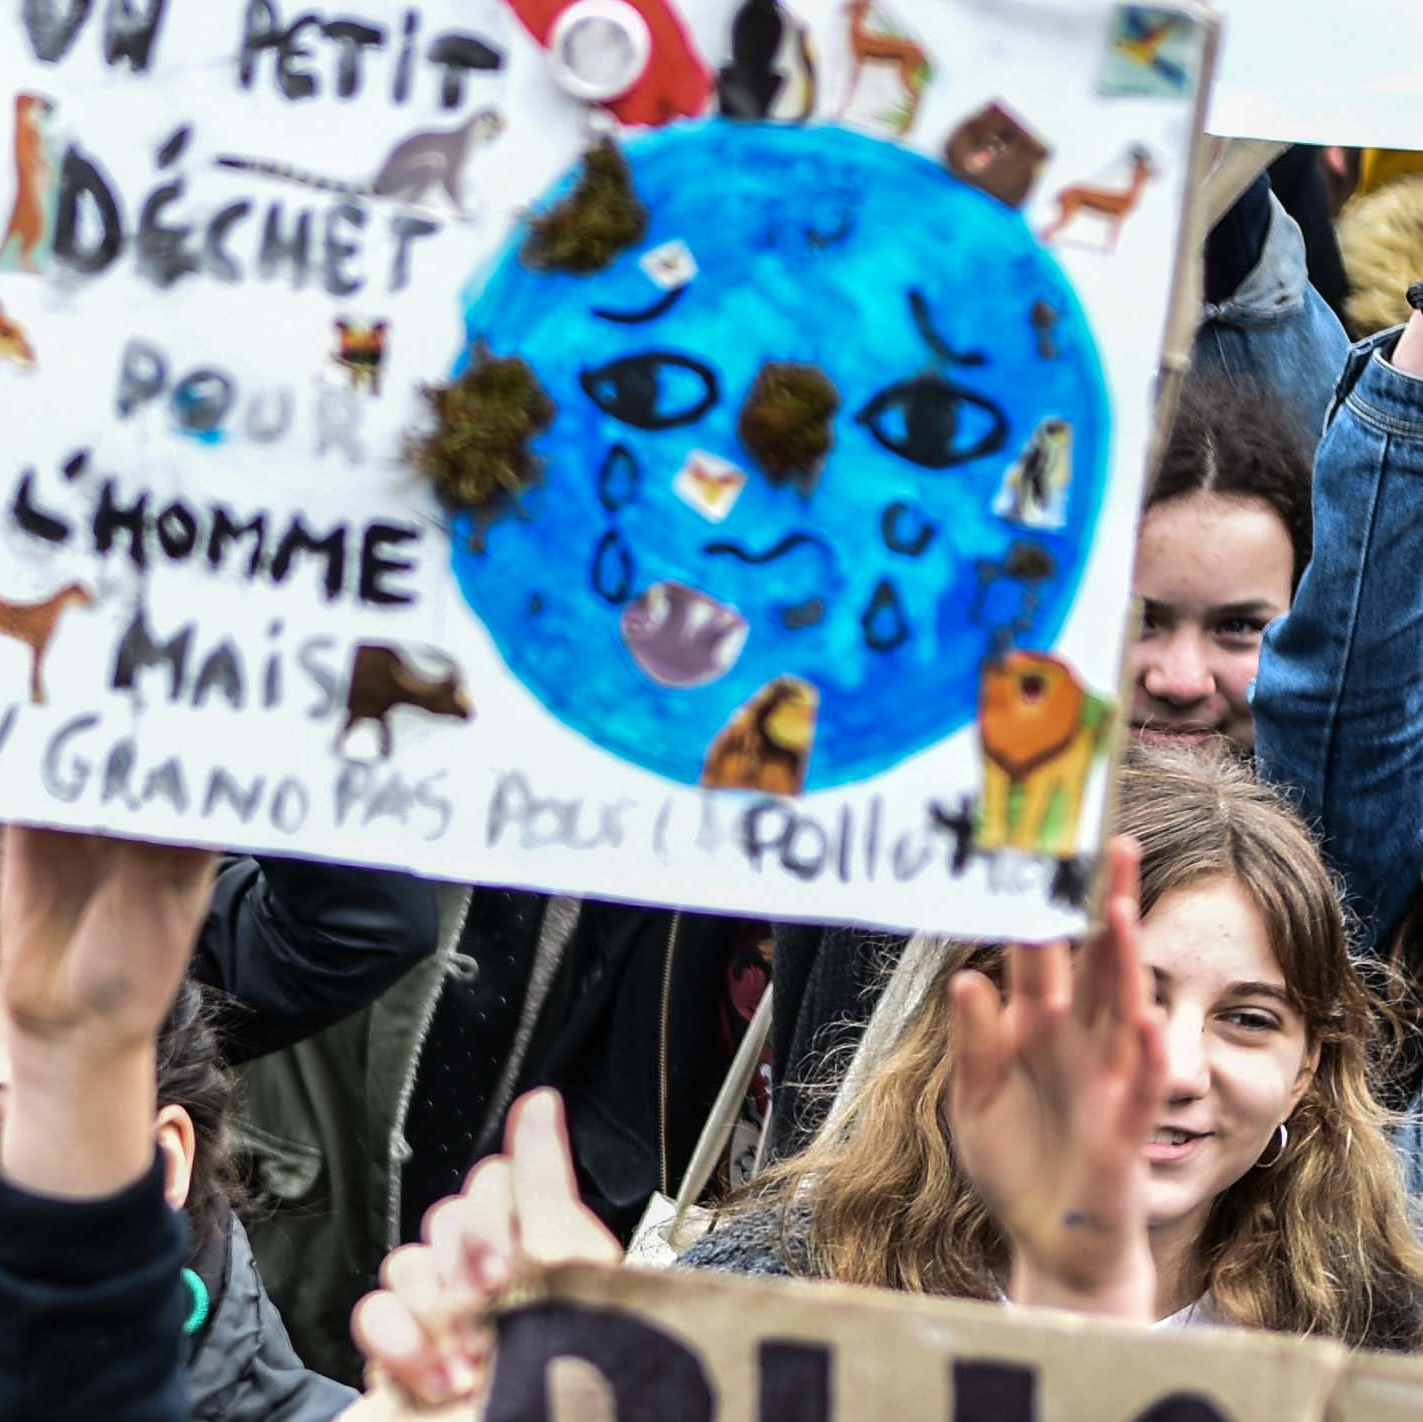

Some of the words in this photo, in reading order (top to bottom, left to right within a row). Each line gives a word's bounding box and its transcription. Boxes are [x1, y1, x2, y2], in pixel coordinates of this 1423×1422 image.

[52, 123, 439, 296] DÉCHET
[118, 335, 364, 466] POUR
[13, 449, 420, 605] L'HOMME
